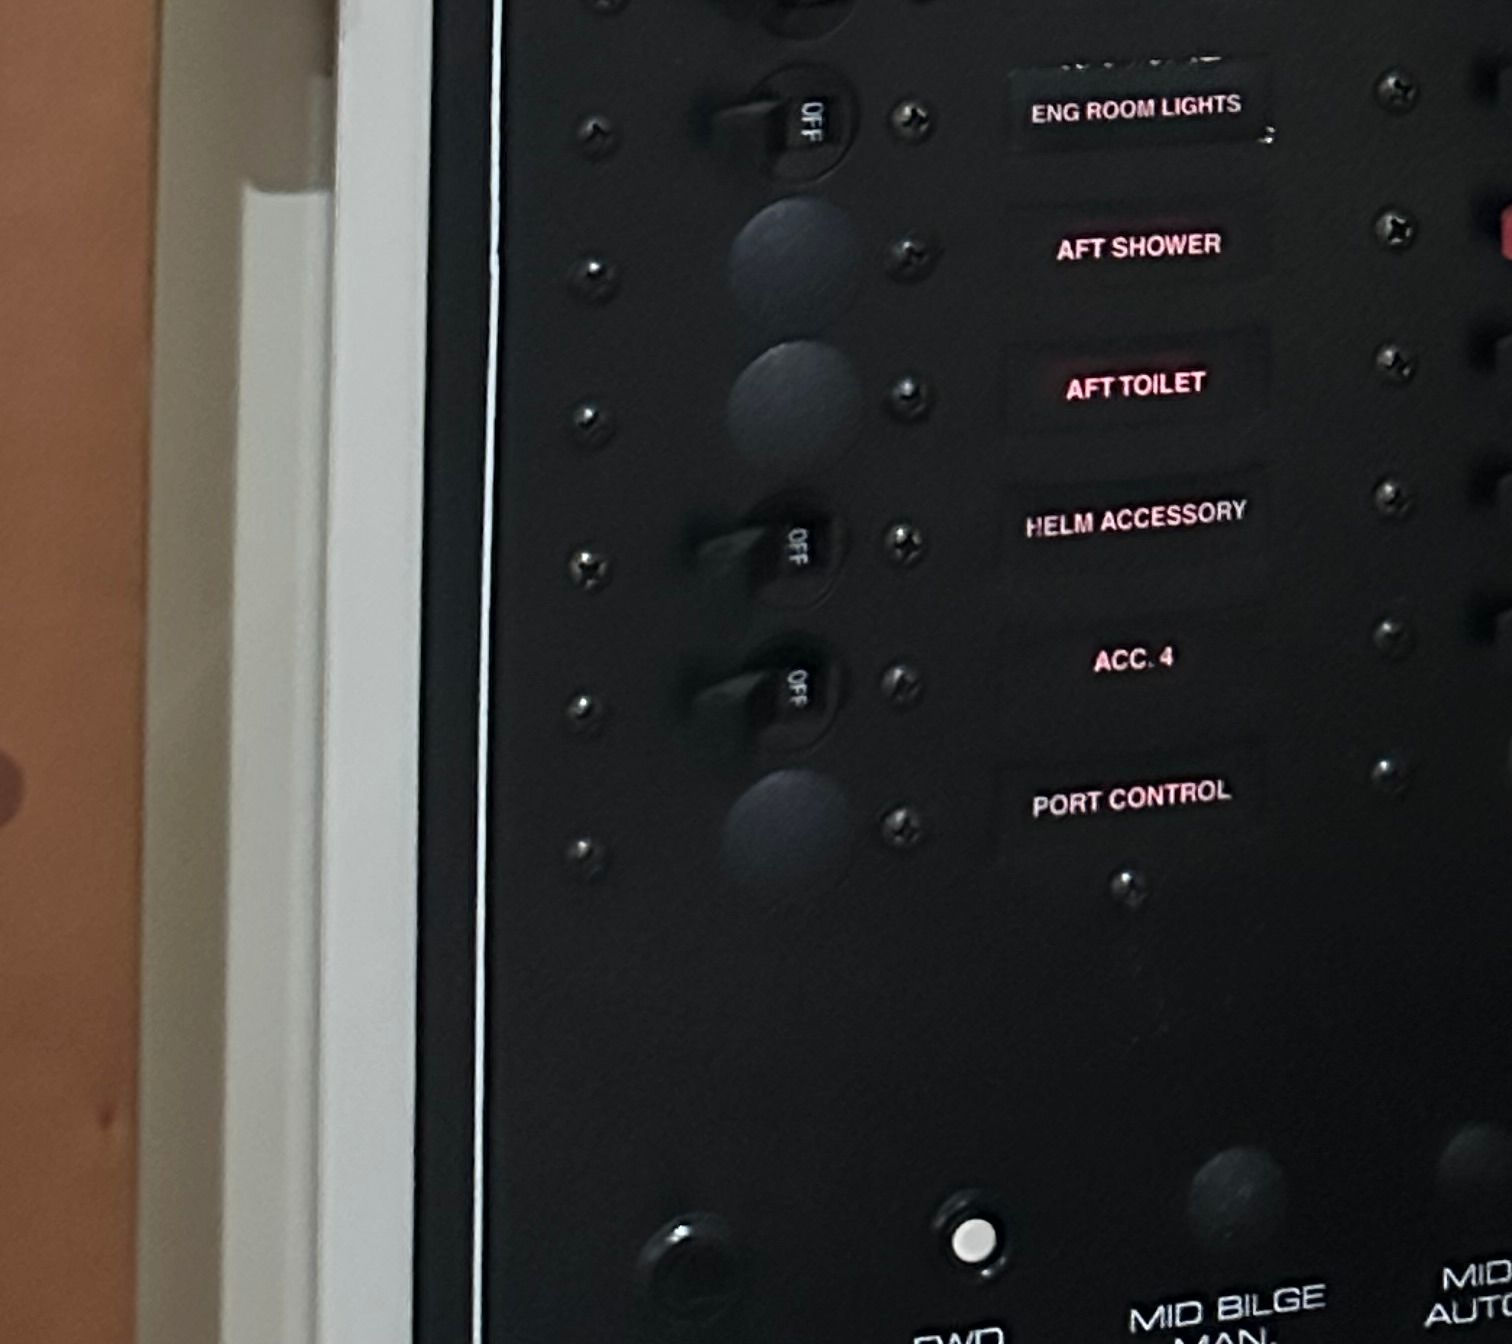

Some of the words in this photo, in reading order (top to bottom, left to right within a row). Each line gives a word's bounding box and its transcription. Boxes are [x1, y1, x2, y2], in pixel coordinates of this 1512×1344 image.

[800, 102, 823, 142] OFF
[1031, 102, 1080, 124] ENG
[1085, 98, 1156, 121] ROOM
[1161, 93, 1242, 117] LIGHTS
[1056, 237, 1107, 261] AFT
[1110, 232, 1222, 259] SHOWER
[1065, 376, 1116, 401] AFT
[1117, 370, 1207, 397] TOILET
[1026, 511, 1094, 538] HELM
[1099, 499, 1247, 532] ACCESSORY
[788, 528, 809, 566] OFF
[1093, 647, 1154, 673] ACC.
[1159, 646, 1174, 667] 4
[787, 669, 808, 707] OFF
[1032, 790, 1103, 818] PORT
[1108, 779, 1232, 811] CONTROL
[1442, 1259, 1512, 1291] MID
[1129, 1300, 1203, 1333] MID
[1217, 1283, 1327, 1321] BILGE
